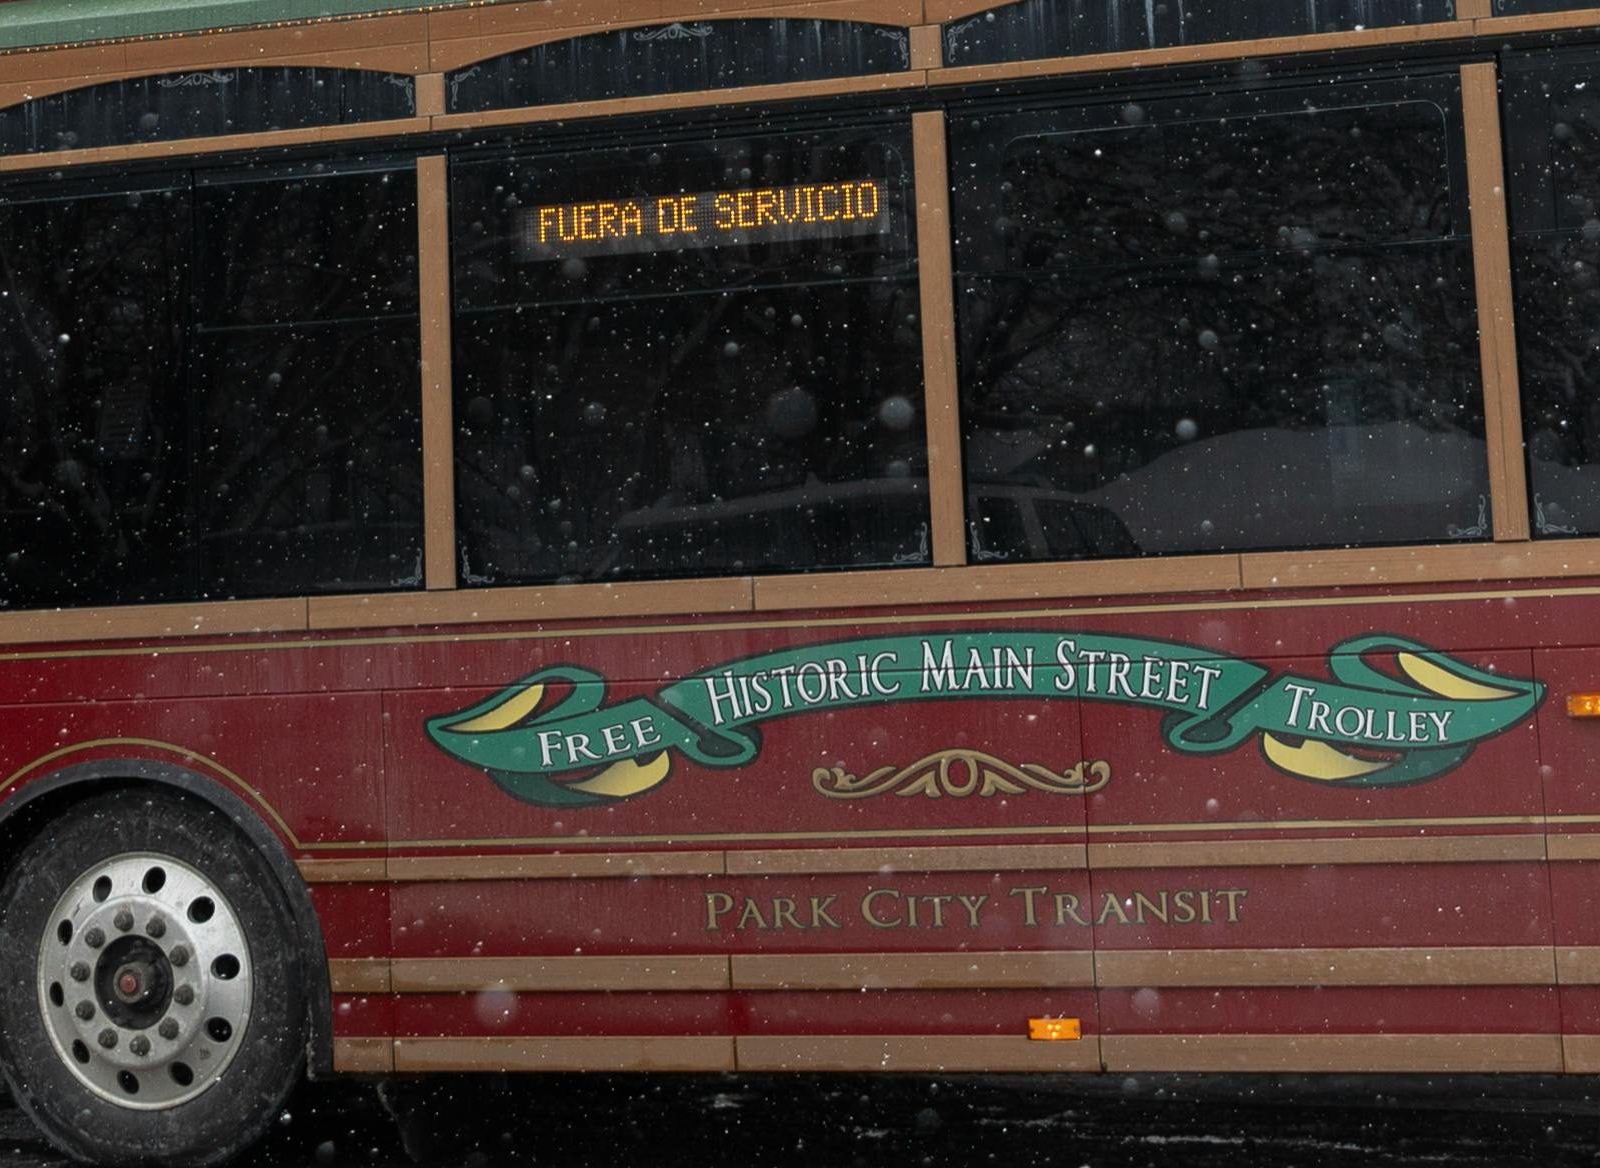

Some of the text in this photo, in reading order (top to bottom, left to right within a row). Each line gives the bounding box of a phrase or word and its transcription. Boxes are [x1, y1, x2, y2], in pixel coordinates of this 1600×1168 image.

[539, 182, 878, 243] FUERA DE SERVICIO
[536, 639, 1452, 767] FREE HISTORIC MAIN STREET TROLLEY
[704, 886, 1249, 929] PARK CITY TRANSIT
